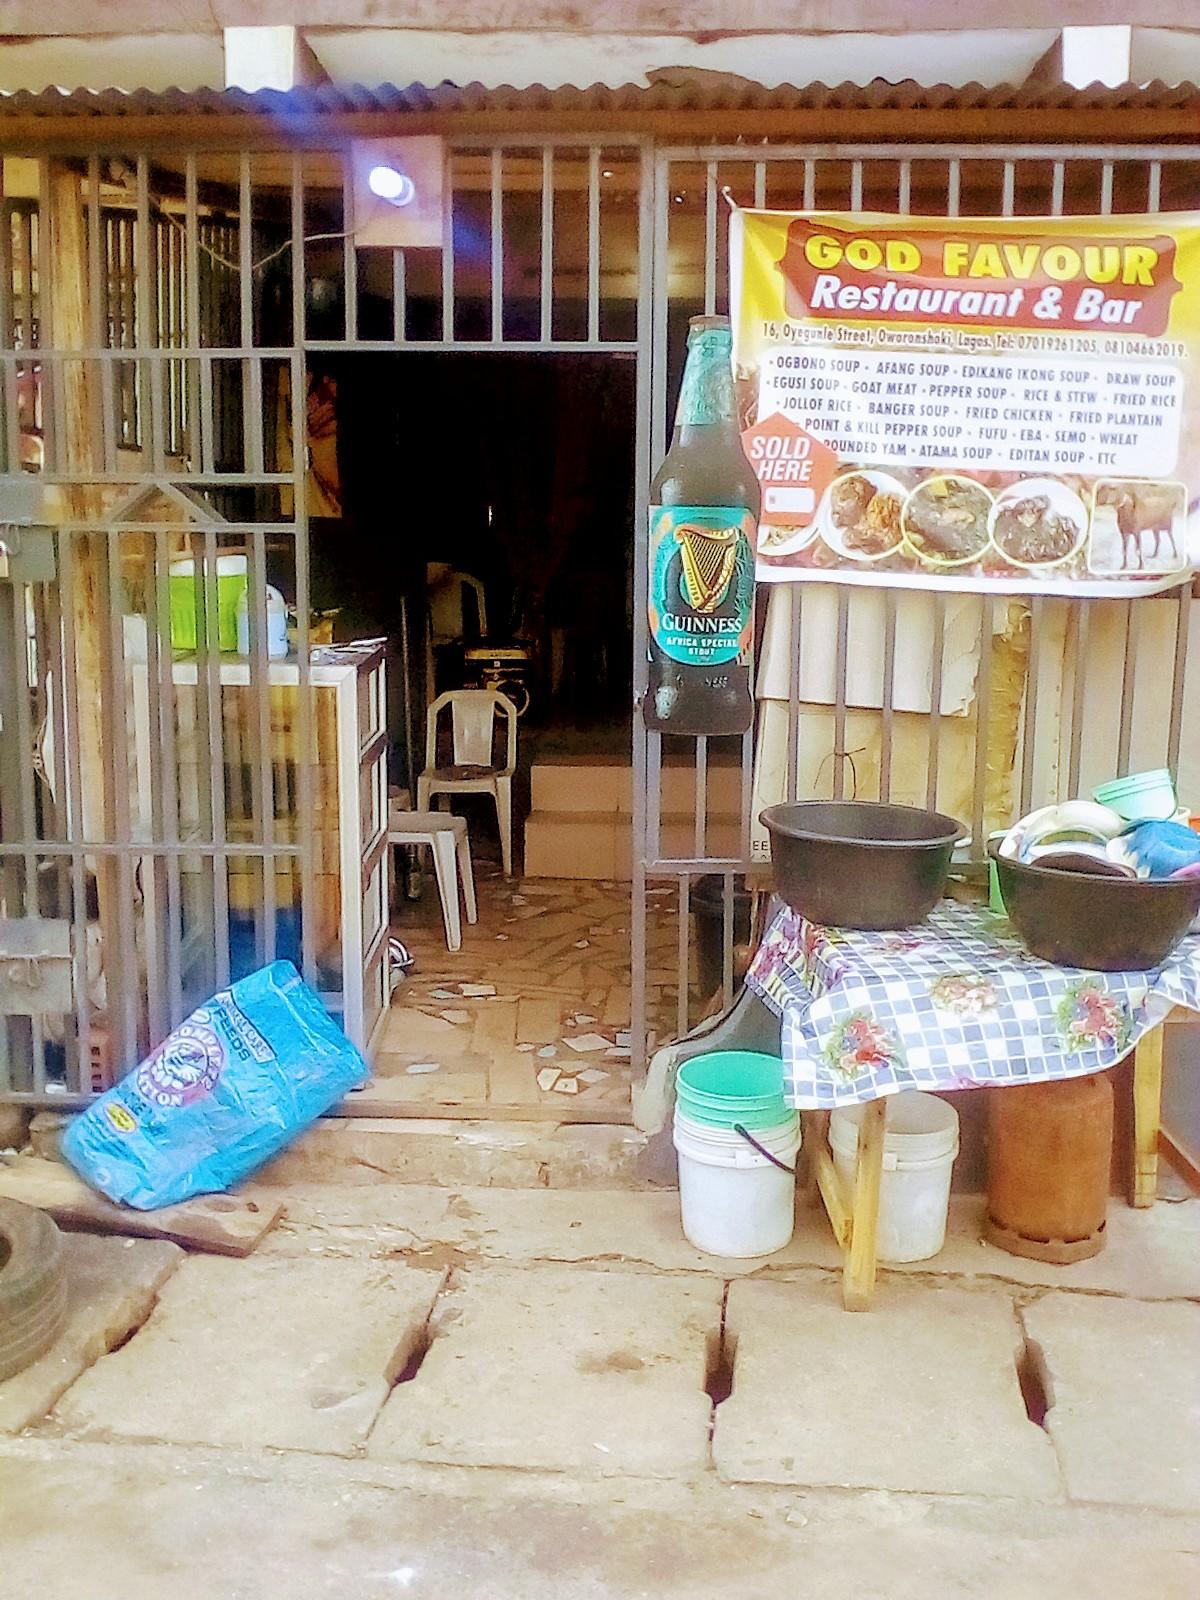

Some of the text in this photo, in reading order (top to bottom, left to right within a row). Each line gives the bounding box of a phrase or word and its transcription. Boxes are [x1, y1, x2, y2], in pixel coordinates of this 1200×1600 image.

[804, 235, 1160, 286] GOD FAVOUR
[811, 275, 1143, 324] Restaurant & Bar
[764, 323, 779, 339] 16,
[837, 327, 874, 344] Street,
[777, 356, 1175, 387] OGBONO SOUP AFANG SOUP EDIKANG IKONG SOUP DRAW SOUP
[773, 376, 1176, 407] EGUSI SOUP GOAT MEAT PEPPER SOUP RICE & STEW FRIED RICE
[783, 396, 1163, 427] JOLLOF RICE BANGER SOUP FRIED CHICKEN FRIED PLANTAIN
[805, 418, 1138, 446] POINT & KILL PEPPER SOUP FUFU EBA SEMO WHEAT
[750, 436, 811, 460] SOLD
[881, 442, 906, 456] YAM
[919, 444, 958, 458] ATAMA
[963, 446, 992, 459] SOUP
[1009, 448, 1049, 461] EDITAN
[1054, 450, 1085, 463] SOUP
[1098, 452, 1116, 465] ETC
[757, 460, 813, 481] HERE
[662, 613, 742, 633] GUINNESS
[666, 636, 738, 648] AFRICA SPECIAL
[688, 647, 715, 656] STOUT
[213, 1007, 251, 1061] FEEDS
